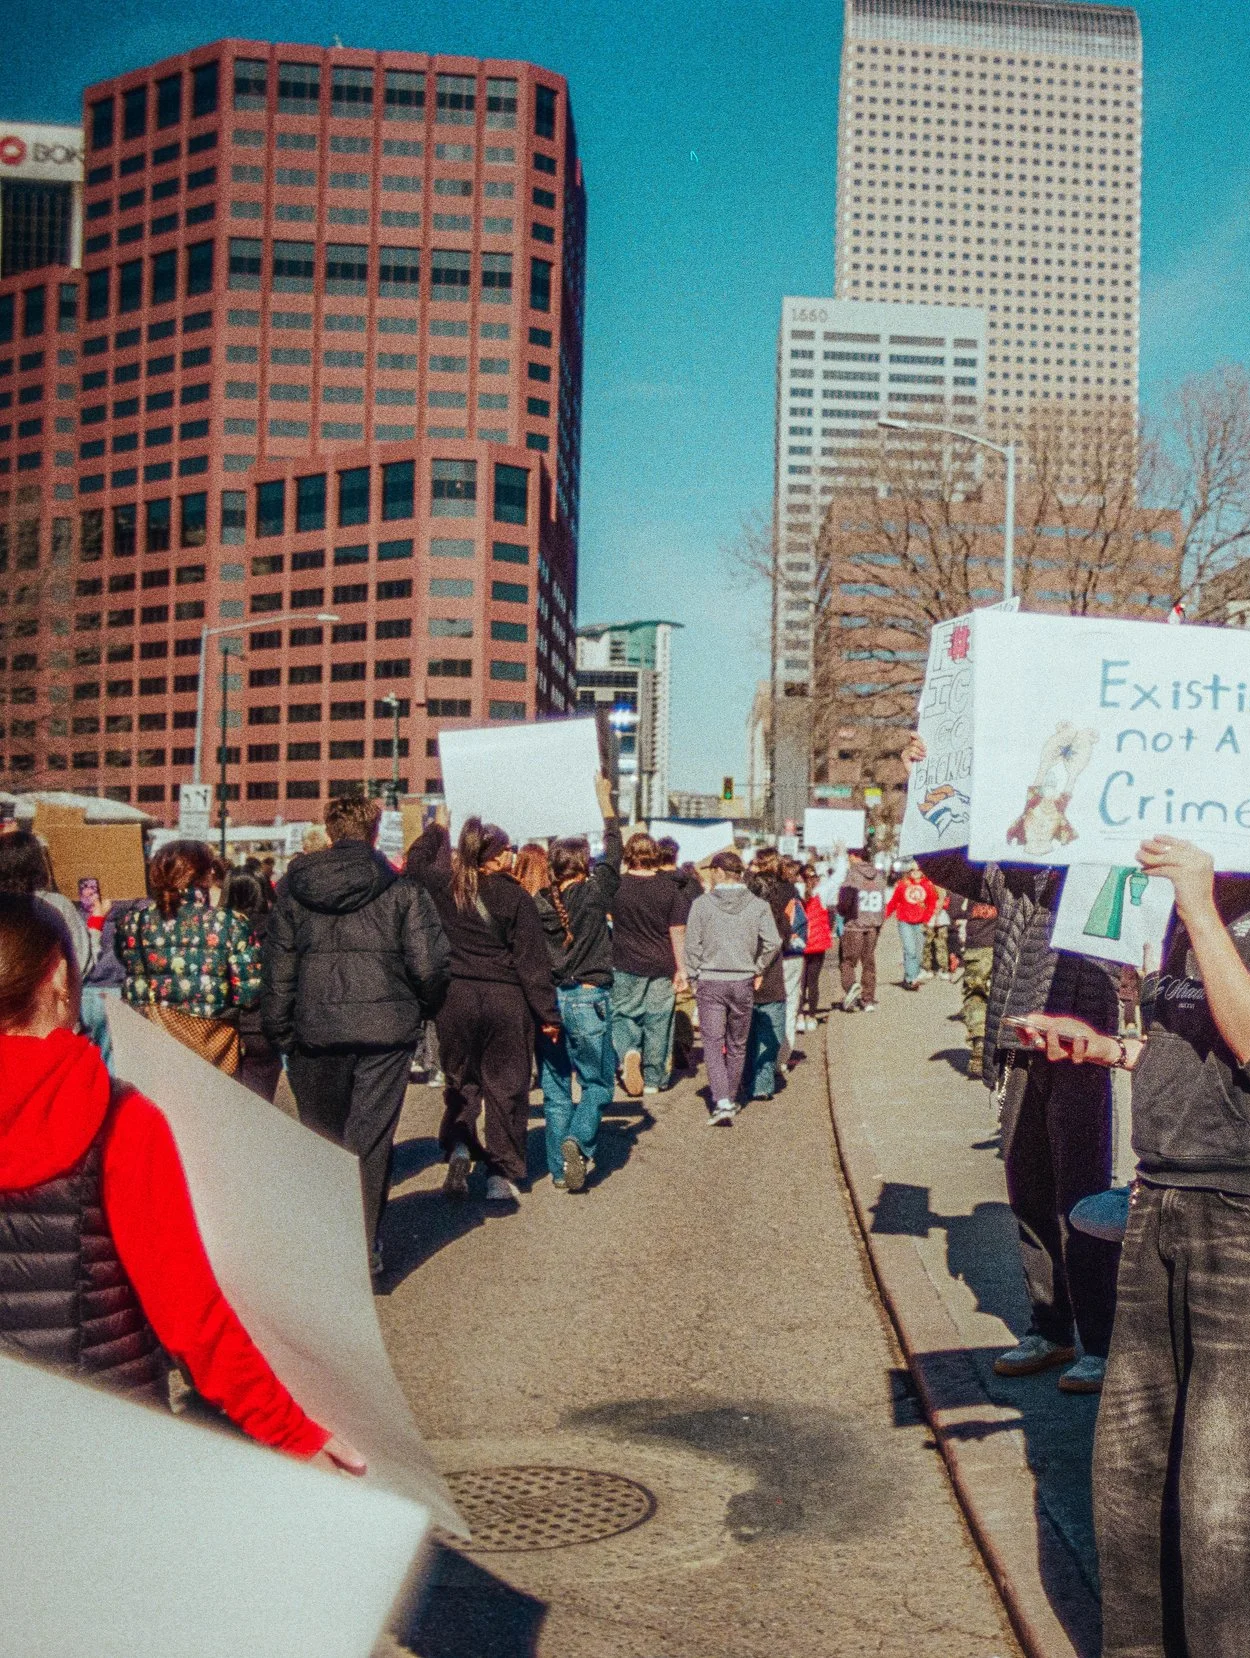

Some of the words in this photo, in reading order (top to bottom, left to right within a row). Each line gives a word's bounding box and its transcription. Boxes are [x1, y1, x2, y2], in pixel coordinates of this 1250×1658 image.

[791, 308, 829, 323] 1660
[1116, 727, 1198, 753] not
[1215, 724, 1241, 754] A
[858, 890, 883, 912] 28
